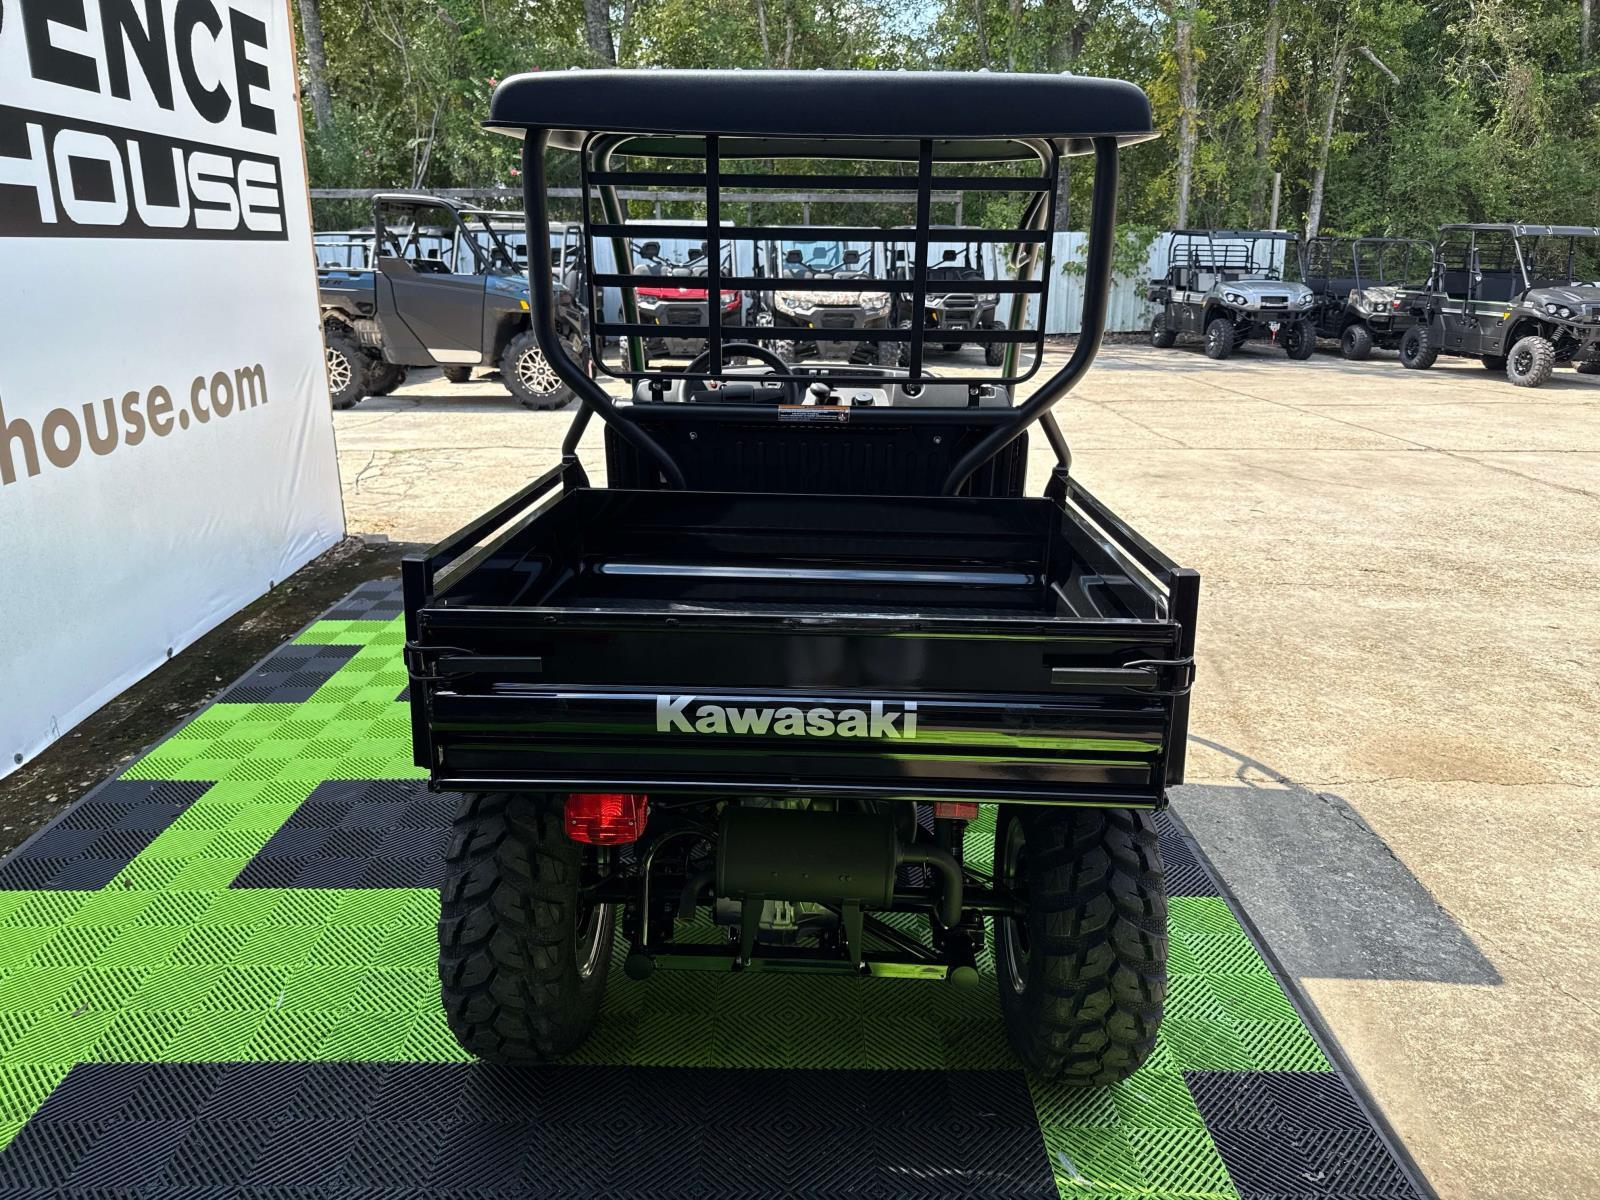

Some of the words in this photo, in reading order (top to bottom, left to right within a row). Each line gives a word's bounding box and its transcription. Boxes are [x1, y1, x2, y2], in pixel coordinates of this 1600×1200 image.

[0, 0, 277, 135] ENCE
[0, 363, 268, 485] house.com
[657, 695, 917, 738] Kawasaki
